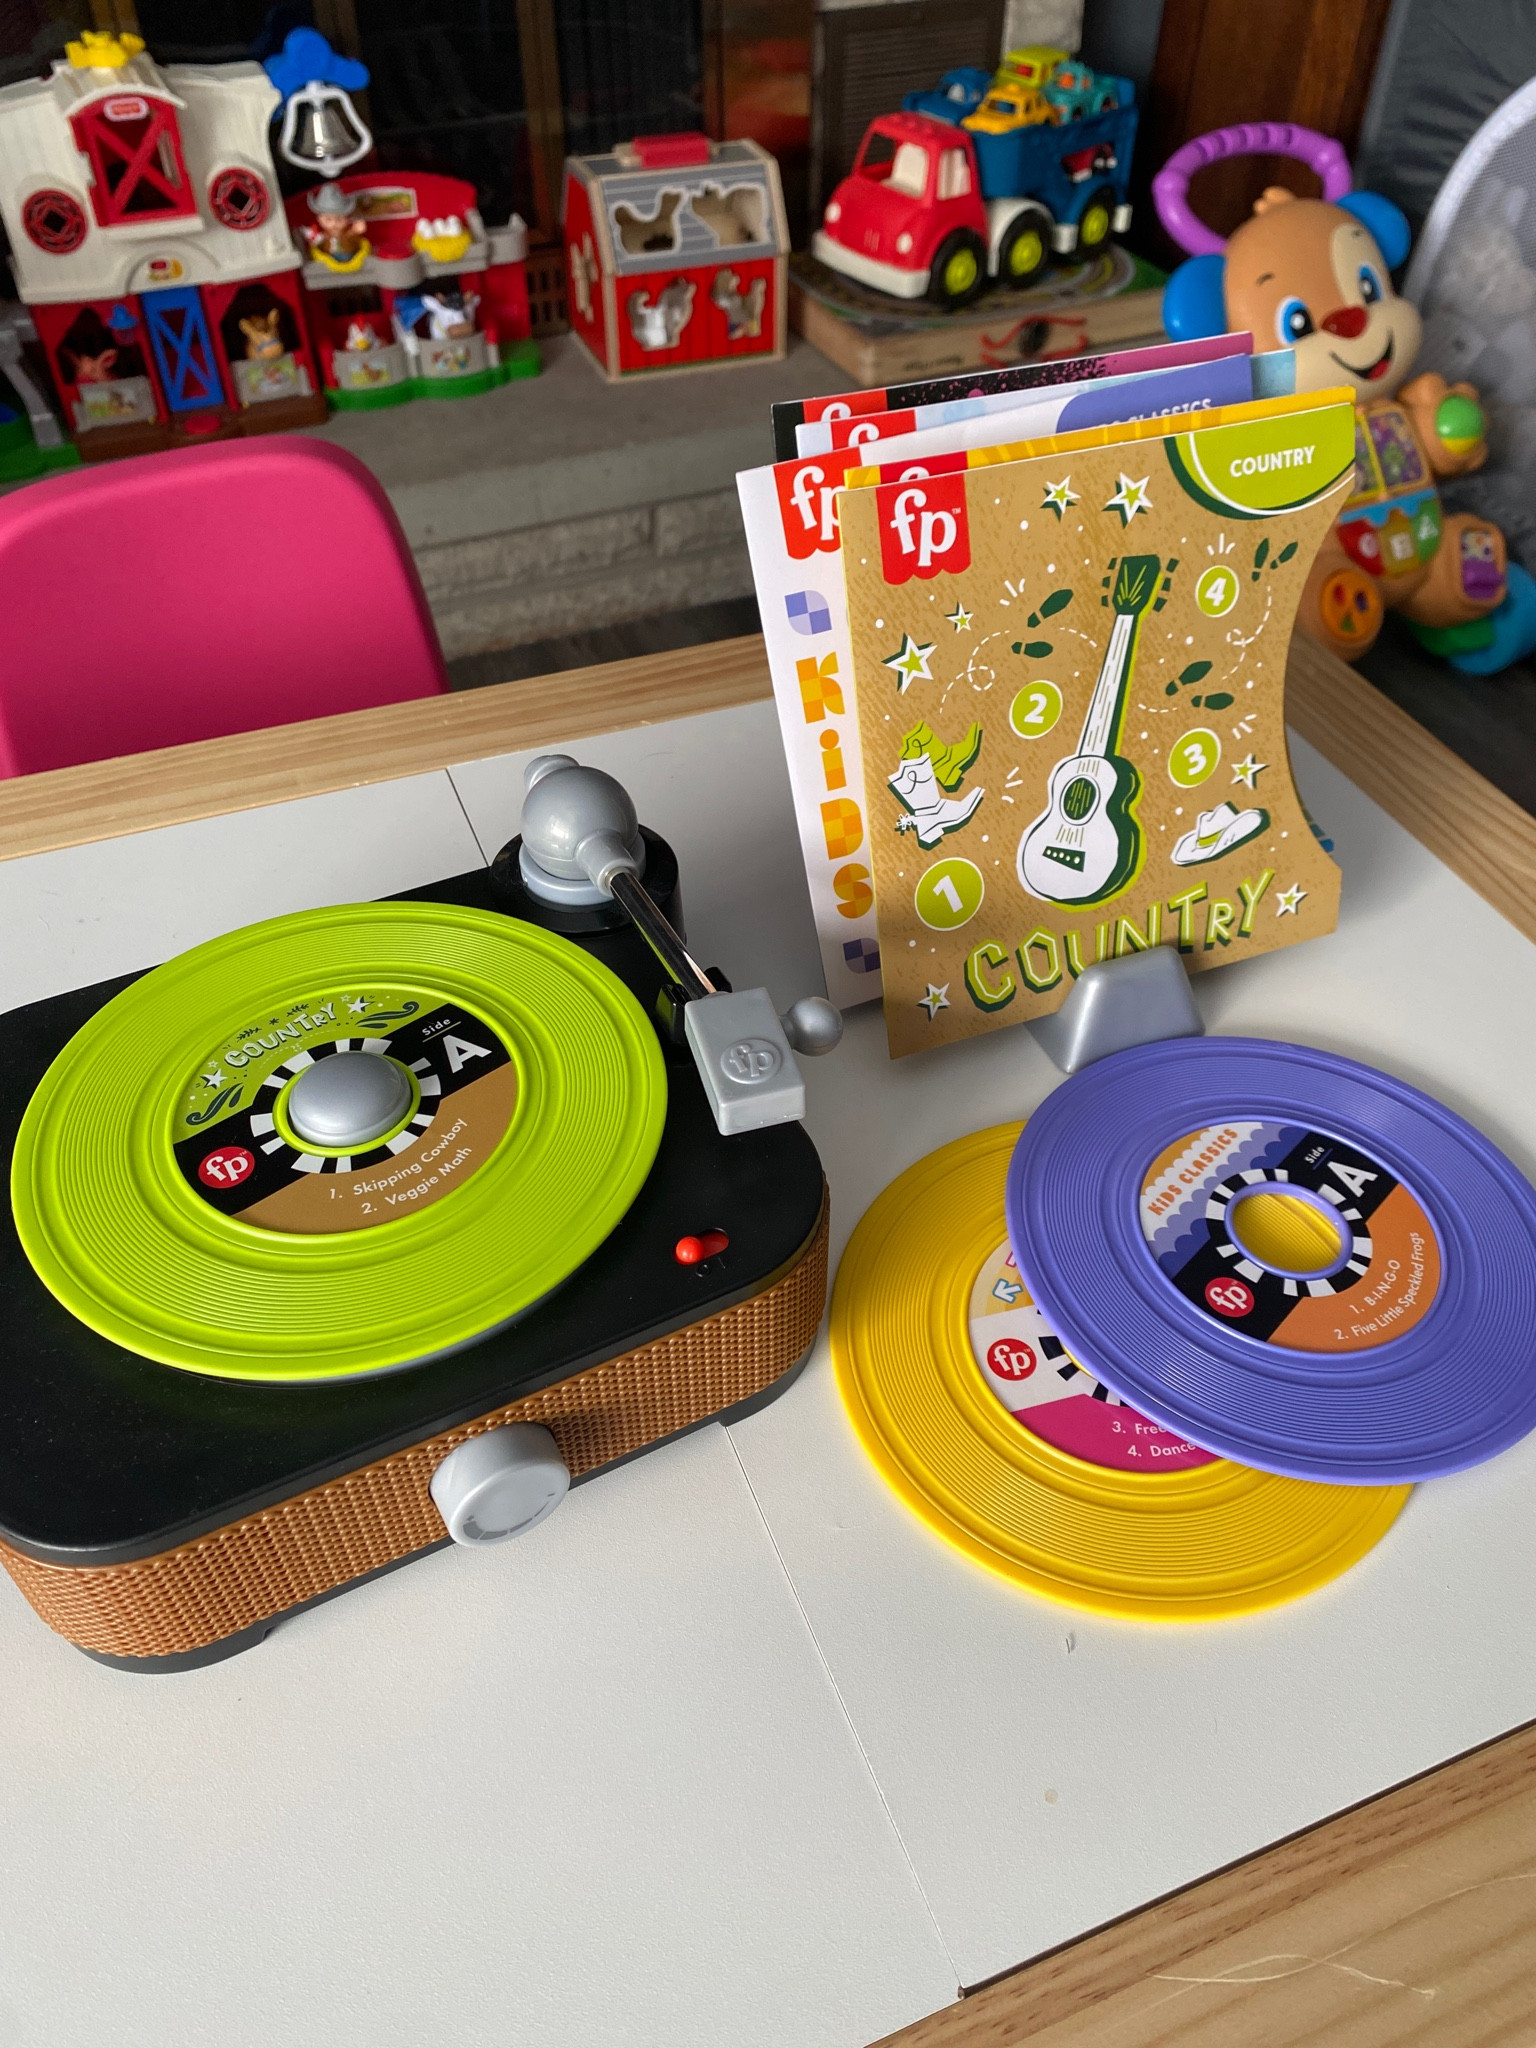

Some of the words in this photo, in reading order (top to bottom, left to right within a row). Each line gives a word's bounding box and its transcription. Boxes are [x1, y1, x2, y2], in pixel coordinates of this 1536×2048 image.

[1230, 445, 1315, 477] COUNTRY
[890, 488, 957, 566] fp
[1204, 577, 1227, 606] 4
[1024, 693, 1048, 724] 2
[1183, 743, 1207, 776] 3
[934, 874, 965, 914] 1
[964, 868, 1275, 1011] COUNTRY
[224, 1002, 337, 1068] COUNTRY
[422, 1019, 451, 1036] Side
[442, 1034, 493, 1074] A
[206, 1155, 248, 1181] fp
[330, 1188, 343, 1199] 1.
[353, 1162, 423, 1195] Skipping
[420, 1118, 468, 1162] Cowboy
[1304, 1146, 1325, 1163] Side
[361, 1202, 378, 1214] 2.
[384, 1176, 439, 1205] Veggie
[438, 1147, 473, 1176] Math
[1327, 1161, 1379, 1198] A
[1409, 1232, 1425, 1262] Frogs
[1210, 1286, 1248, 1310] fp
[1397, 1261, 1425, 1308] Speckled
[1349, 1304, 1365, 1314] 1.
[1374, 1306, 1405, 1328] Little
[1334, 1328, 1350, 1340] 2.
[1350, 1323, 1378, 1337] Five
[994, 1344, 1031, 1376] fp
[1112, 1421, 1126, 1434] 3.
[1127, 1445, 1142, 1457] 4.
[1150, 1442, 1196, 1457] Dance
